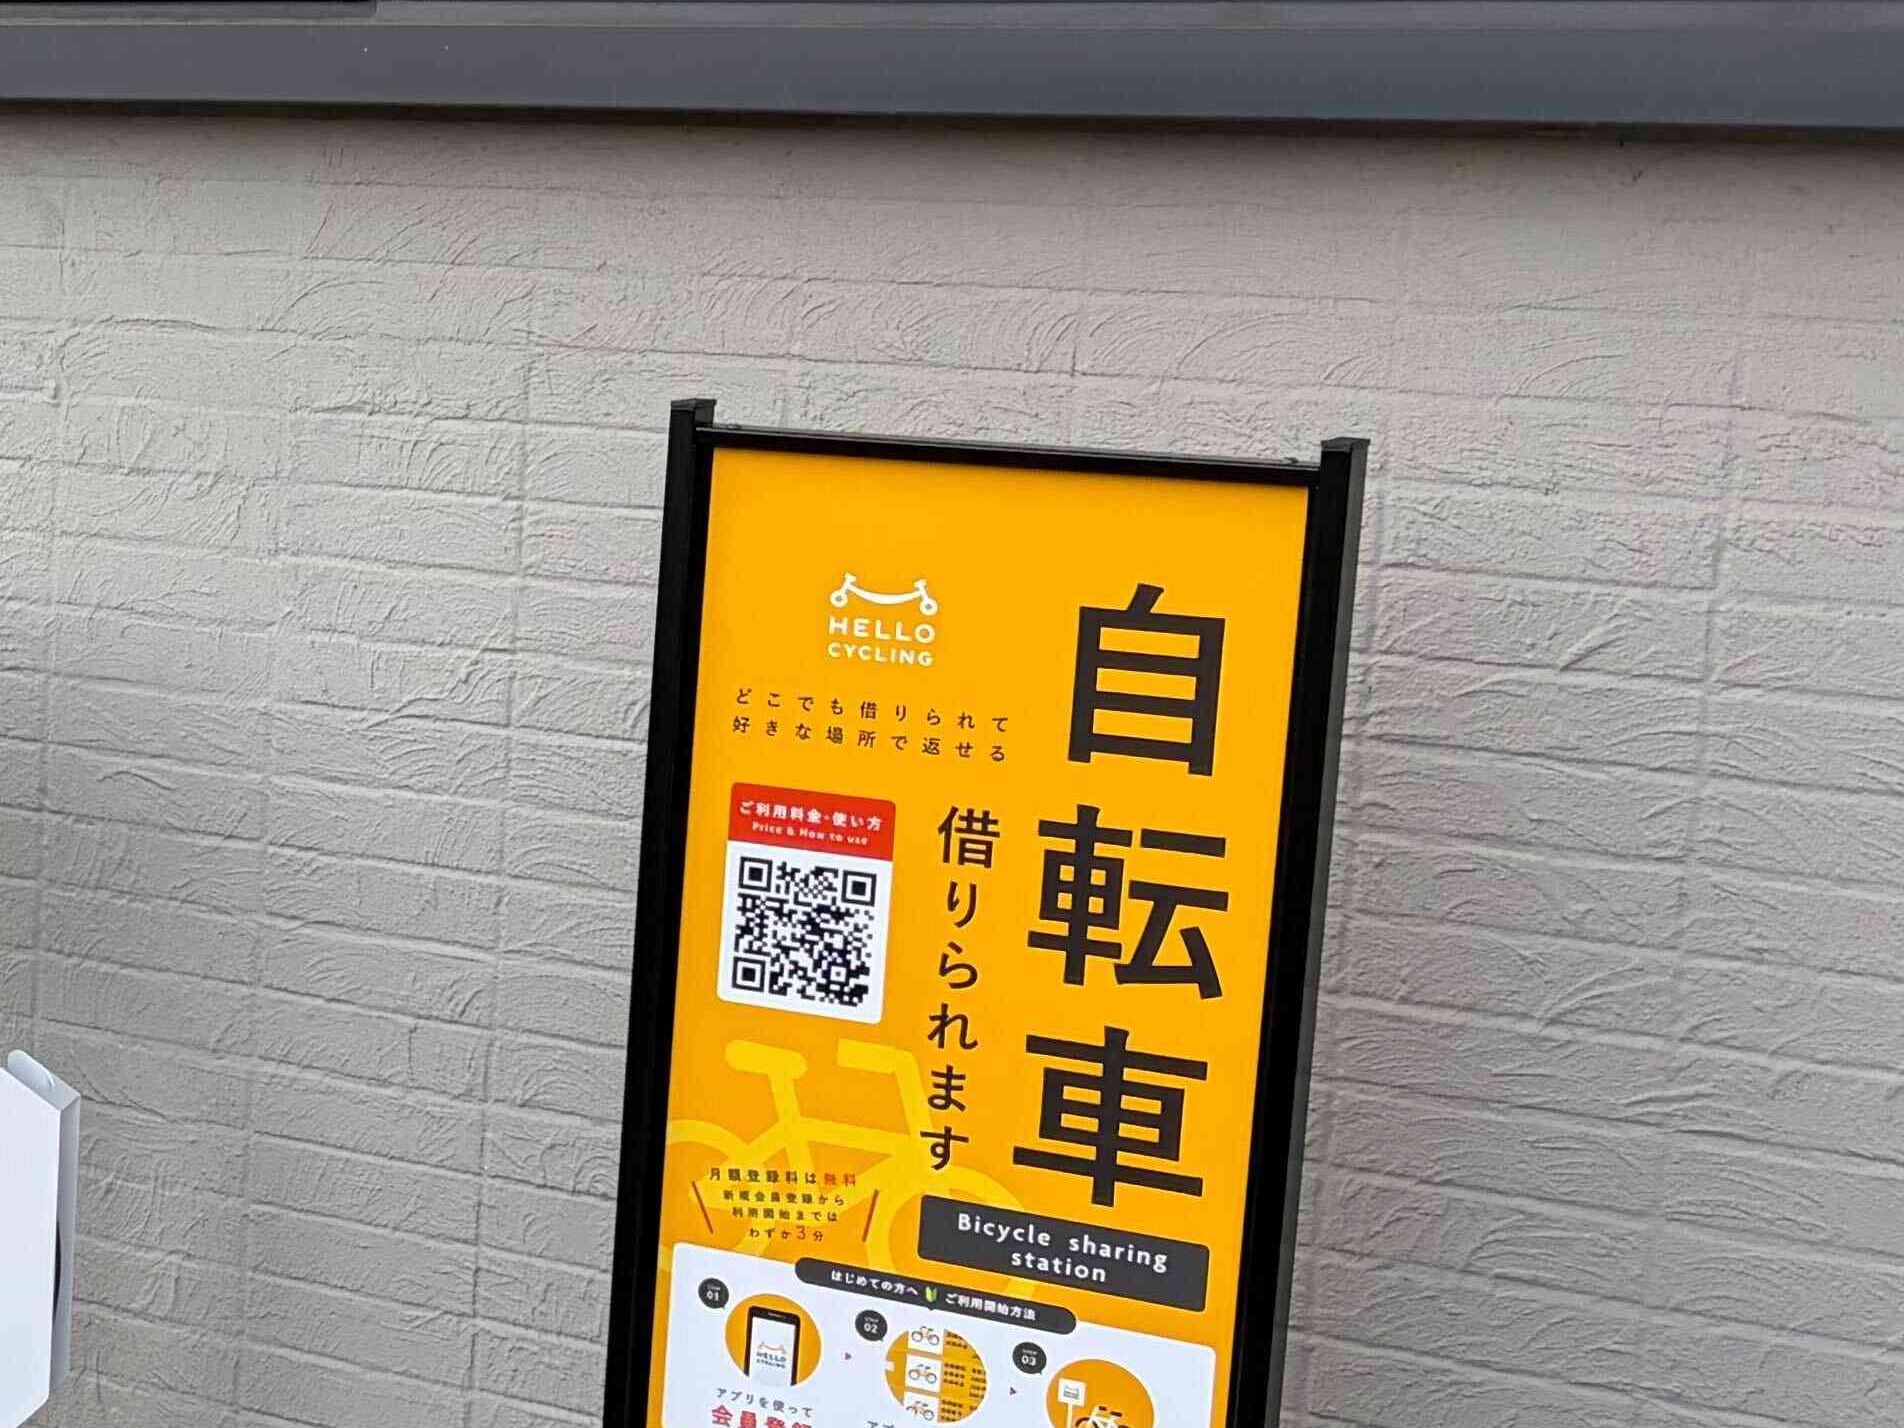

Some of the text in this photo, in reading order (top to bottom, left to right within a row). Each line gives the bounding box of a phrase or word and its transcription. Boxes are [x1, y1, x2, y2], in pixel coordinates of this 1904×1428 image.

[828, 616, 936, 645] HELLO
[827, 641, 934, 668] CYCLING
[735, 687, 1010, 736] どこでも借りられて
[731, 715, 1008, 763] 好きな場所で返せる
[751, 821, 784, 836] Price
[799, 827, 826, 841] How
[829, 831, 844, 843] to
[846, 835, 869, 846] use
[1012, 582, 1229, 1208] 自転車
[920, 804, 1001, 1172] 借りられます
[708, 1165, 858, 1189] 月額登録料は無料
[957, 1213, 1169, 1274] Bicycle sharing
[1010, 1246, 1108, 1284] station
[705, 1291, 720, 1302] 01
[830, 1269, 1038, 1322] はじめての方へ ご利用開始方法
[863, 1323, 879, 1334] 02
[1021, 1355, 1037, 1367] 03
[715, 1386, 815, 1419] アプリを使って
